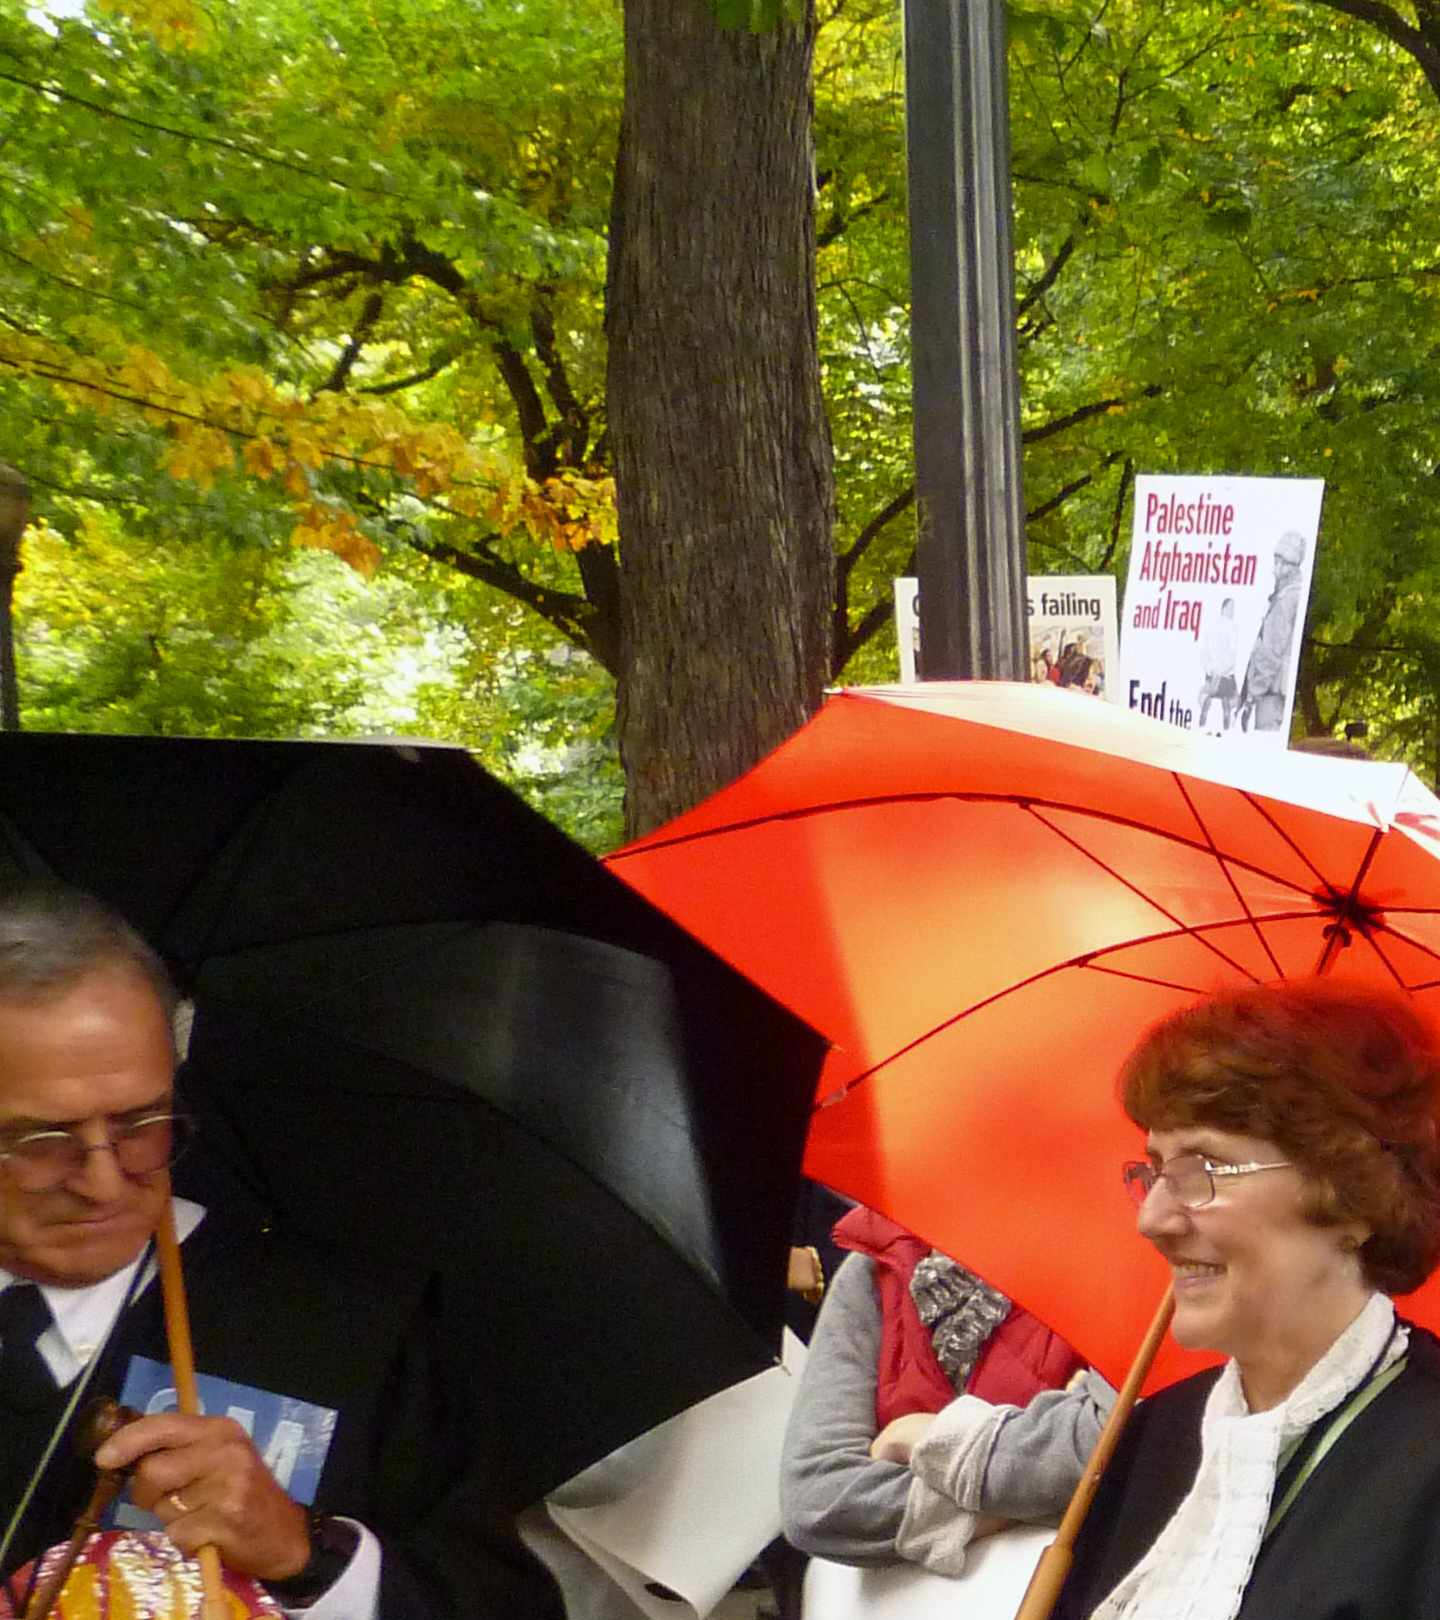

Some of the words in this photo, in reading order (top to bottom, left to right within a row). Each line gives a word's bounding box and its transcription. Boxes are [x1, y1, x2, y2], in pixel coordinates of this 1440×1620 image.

[1145, 492, 1234, 535] Palestine
[1139, 541, 1257, 590] Afghanistan
[1041, 592, 1101, 622] failing
[1132, 599, 1161, 631] and
[1163, 591, 1202, 640] Iraq
[1128, 678, 1167, 722] End
[1169, 700, 1193, 731] the
